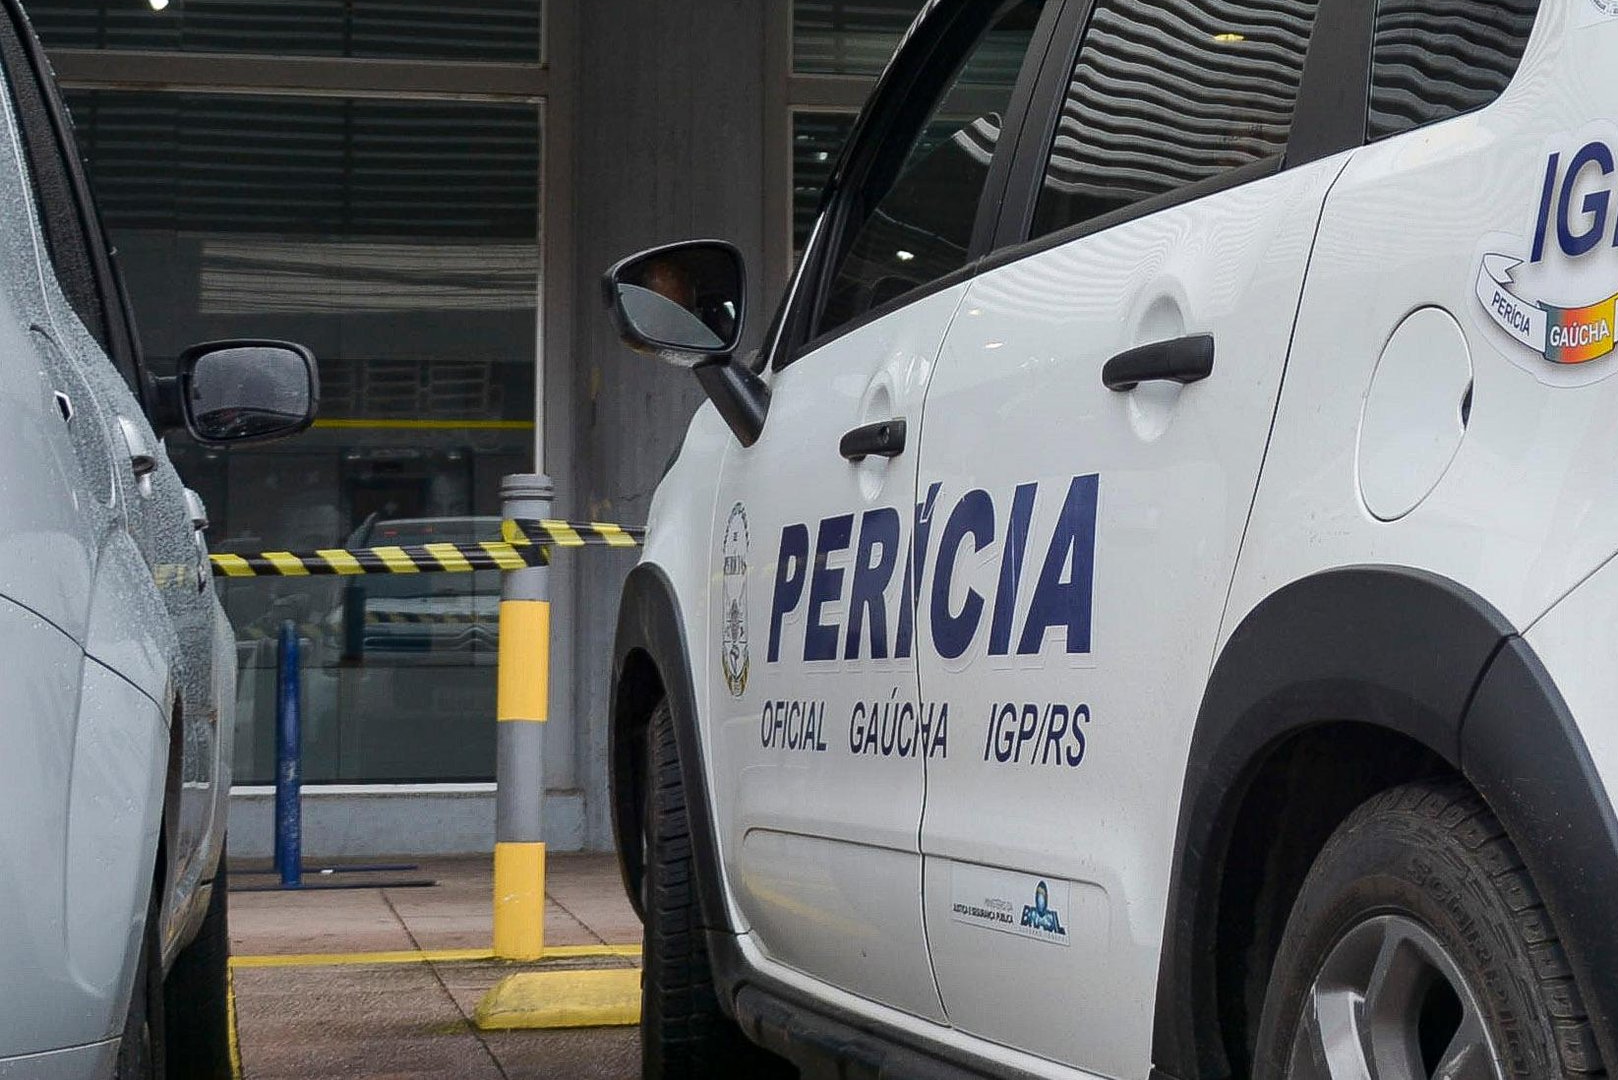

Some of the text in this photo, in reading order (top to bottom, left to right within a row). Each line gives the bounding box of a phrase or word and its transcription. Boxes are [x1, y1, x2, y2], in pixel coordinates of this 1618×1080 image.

[1491, 290, 1530, 337] PERÍCIA
[1550, 318, 1611, 347] GAÚCHA
[766, 473, 1100, 663] PERÍCIA
[761, 687, 1091, 767] OFICIAL GAÚCHA IGP/RS
